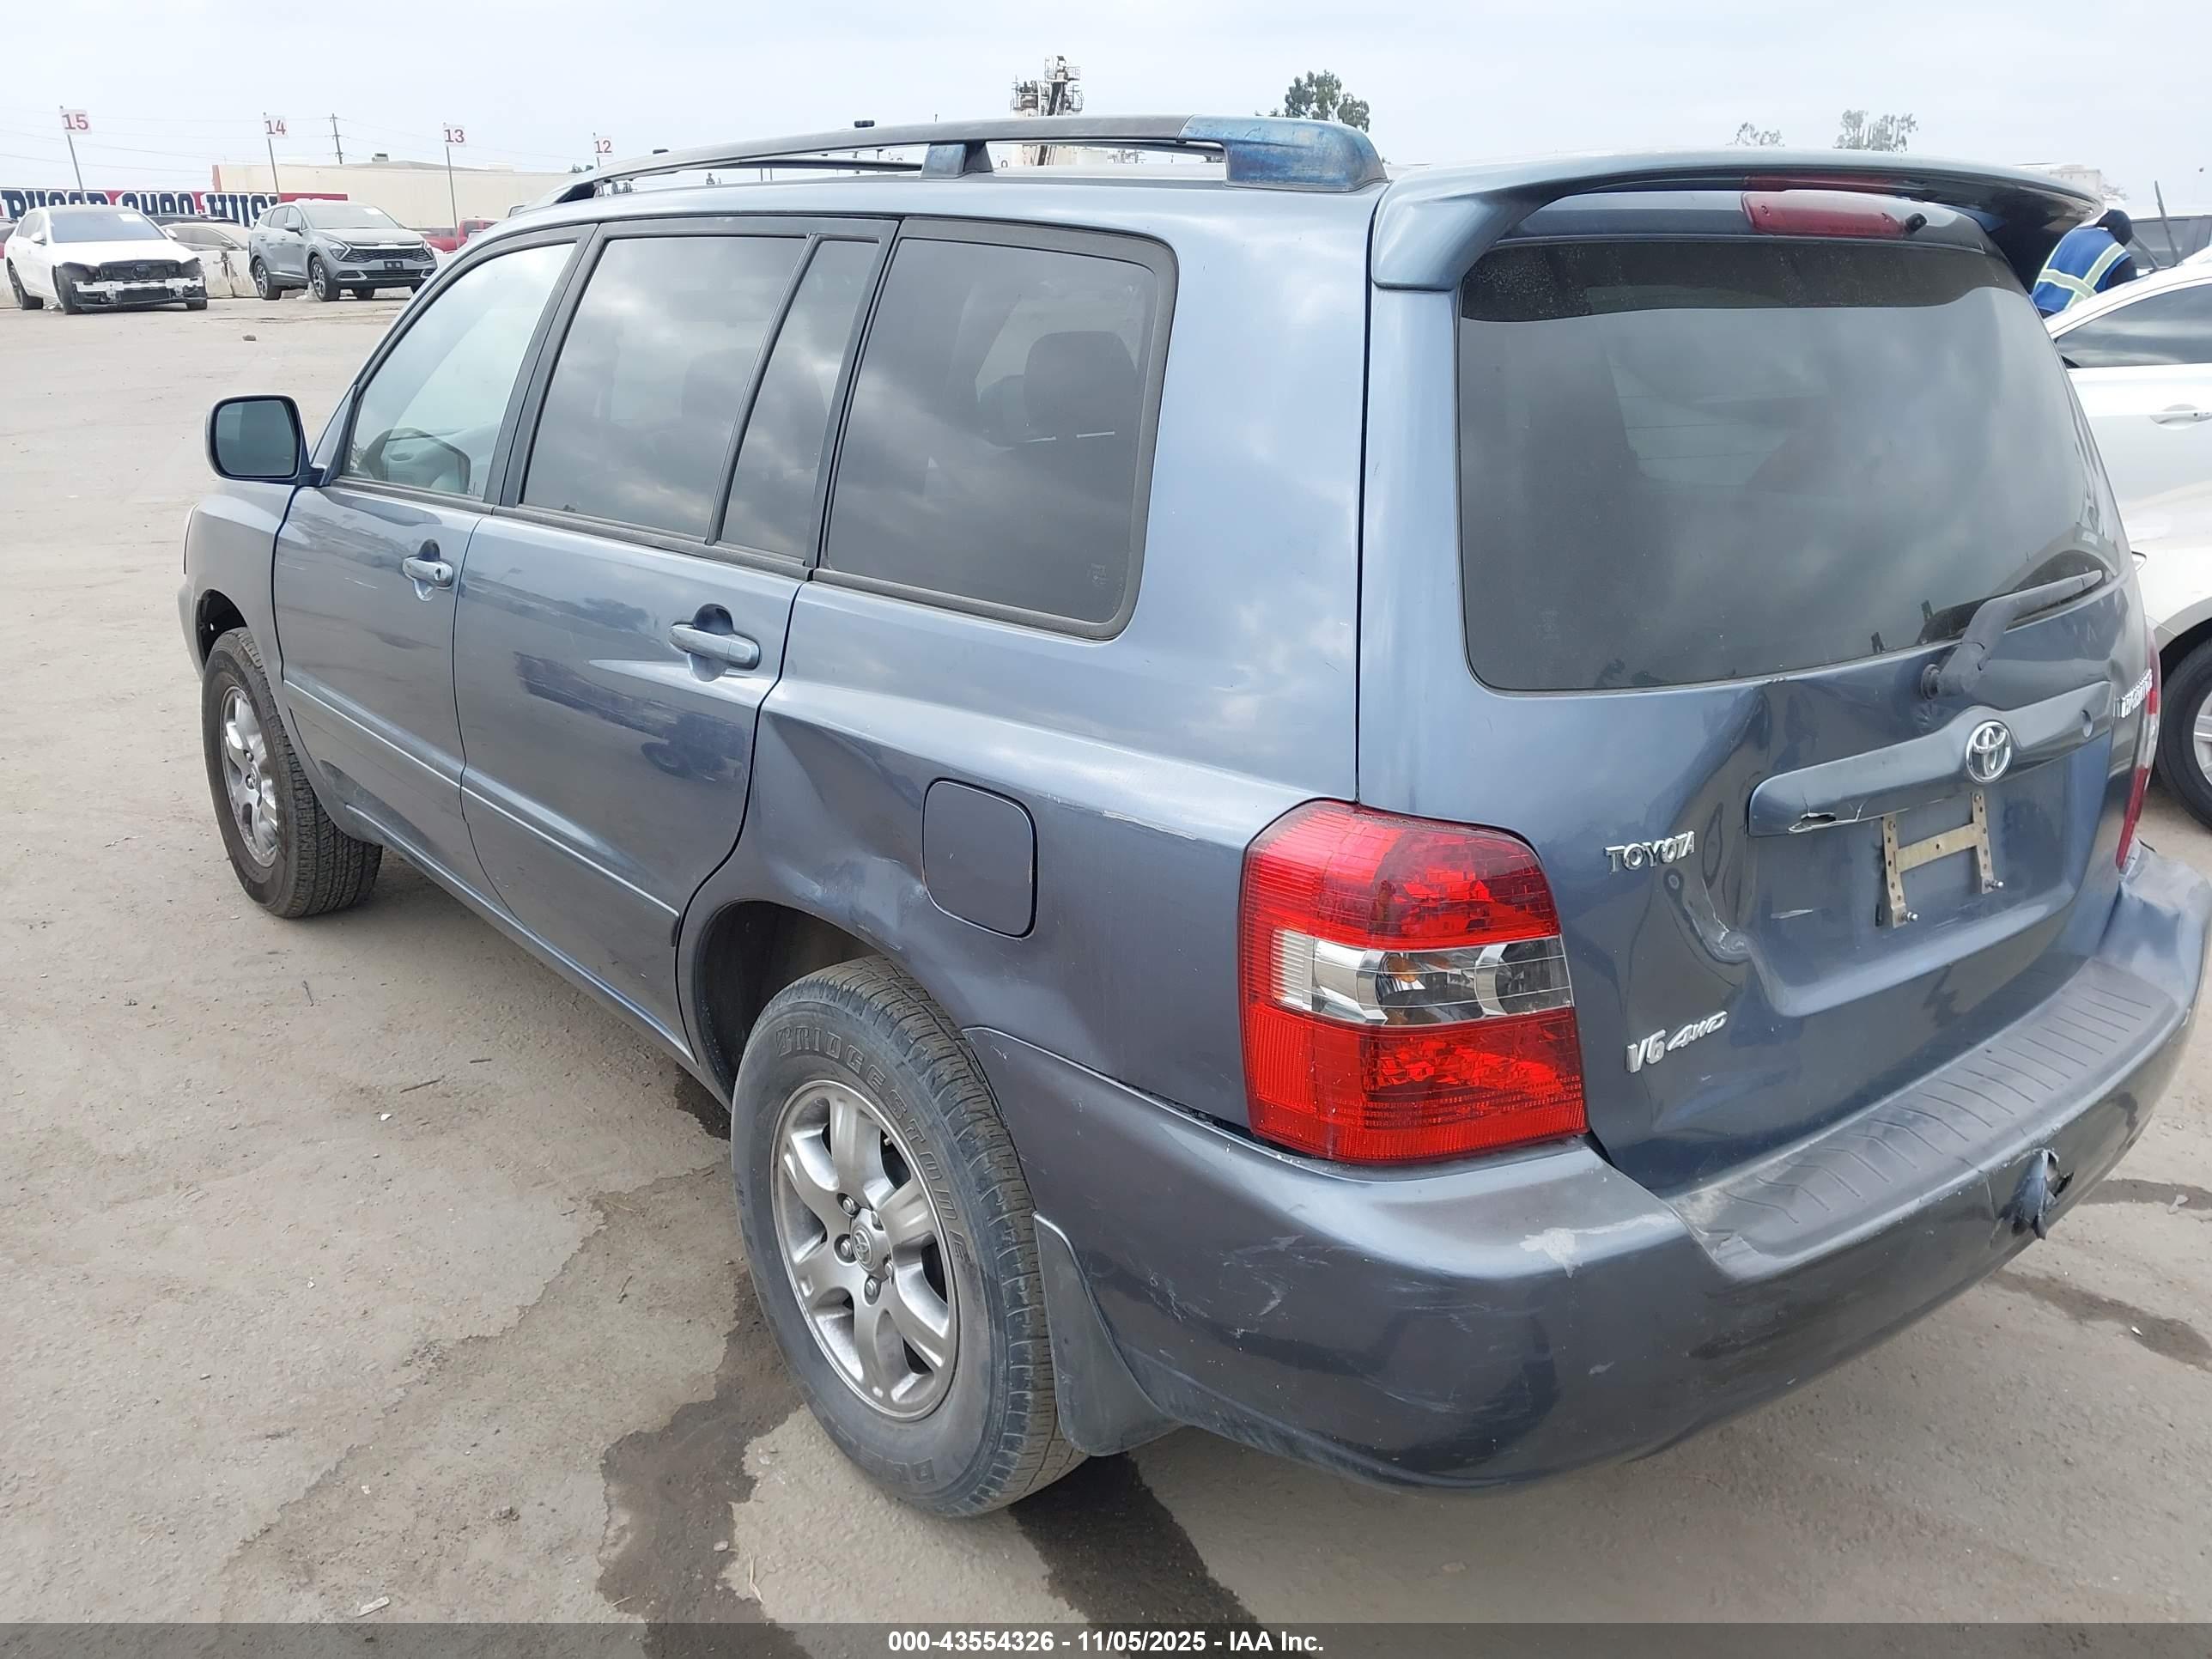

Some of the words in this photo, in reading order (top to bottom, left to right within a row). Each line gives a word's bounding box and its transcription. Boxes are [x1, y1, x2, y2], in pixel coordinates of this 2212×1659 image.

[61, 113, 89, 131] 15
[264, 118, 287, 136] 14
[443, 128, 465, 143] 13
[593, 139, 613, 154] 12
[1603, 830, 1696, 874] TOYOTA
[1626, 1029, 1666, 1073] V6
[1665, 1010, 1729, 1052] 4WD
[775, 1026, 972, 1261] BRIDGESTONE
